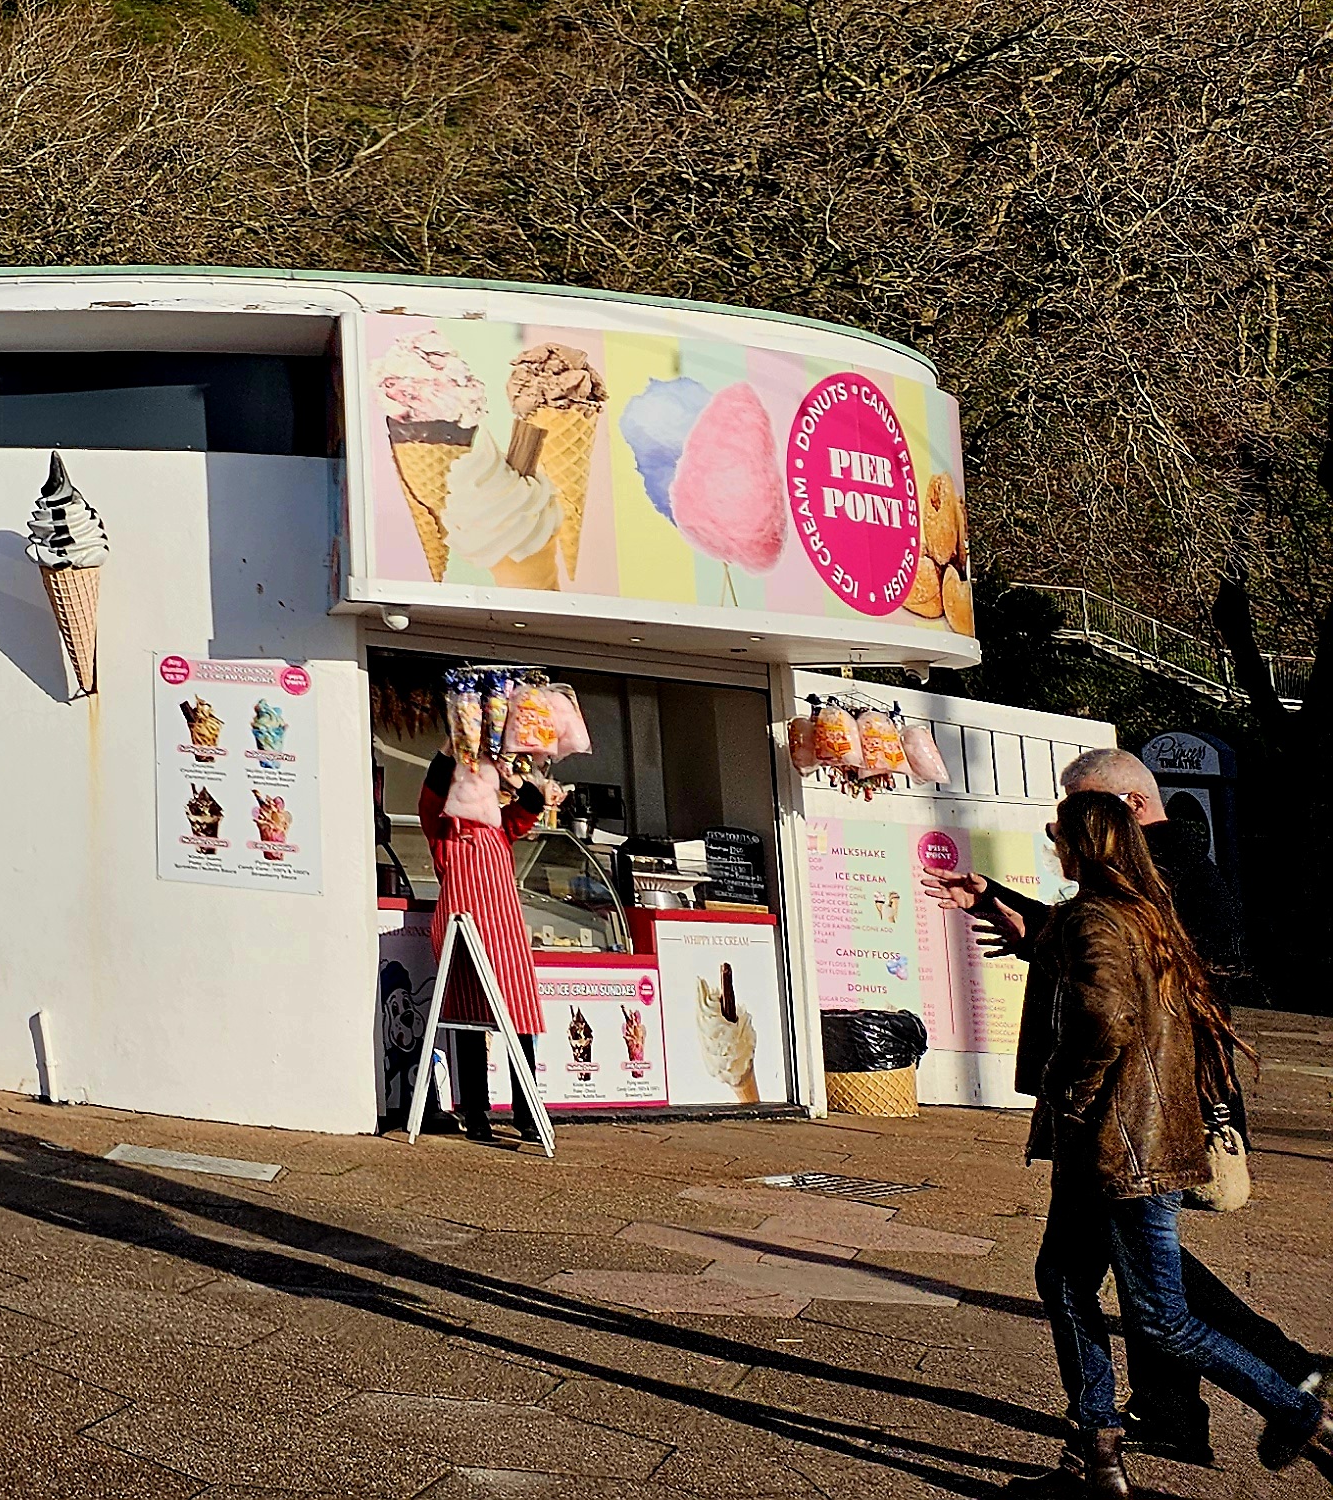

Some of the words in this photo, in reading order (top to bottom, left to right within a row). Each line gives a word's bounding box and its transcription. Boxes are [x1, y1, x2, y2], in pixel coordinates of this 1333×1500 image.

[794, 382, 848, 452] DONUTS
[860, 386, 902, 445] CANDY
[898, 449, 918, 528] FLOSS
[827, 447, 894, 488] PIER
[821, 486, 903, 529] POINT
[794, 477, 832, 567] CREAM
[831, 563, 859, 599] ICE
[883, 549, 915, 603] SLUSH
[1152, 735, 1207, 760] Princess
[1159, 757, 1203, 771] THEATRE
[831, 847, 886, 858] MILKSHAKE
[835, 872, 850, 880] ICE
[853, 874, 887, 883] CREAM
[1005, 875, 1041, 885] SWEETS
[683, 935, 712, 945] WHIPPY
[713, 936, 724, 945] ICE
[724, 936, 749, 946] CREAM
[836, 948, 869, 958] CANDY
[872, 951, 901, 960] FLOSS
[1004, 973, 1023, 982] HOT
[557, 983, 570, 996] ICE
[571, 983, 598, 996] CREAM
[599, 984, 636, 997] SUNDAES
[847, 984, 888, 994] DONUTS
